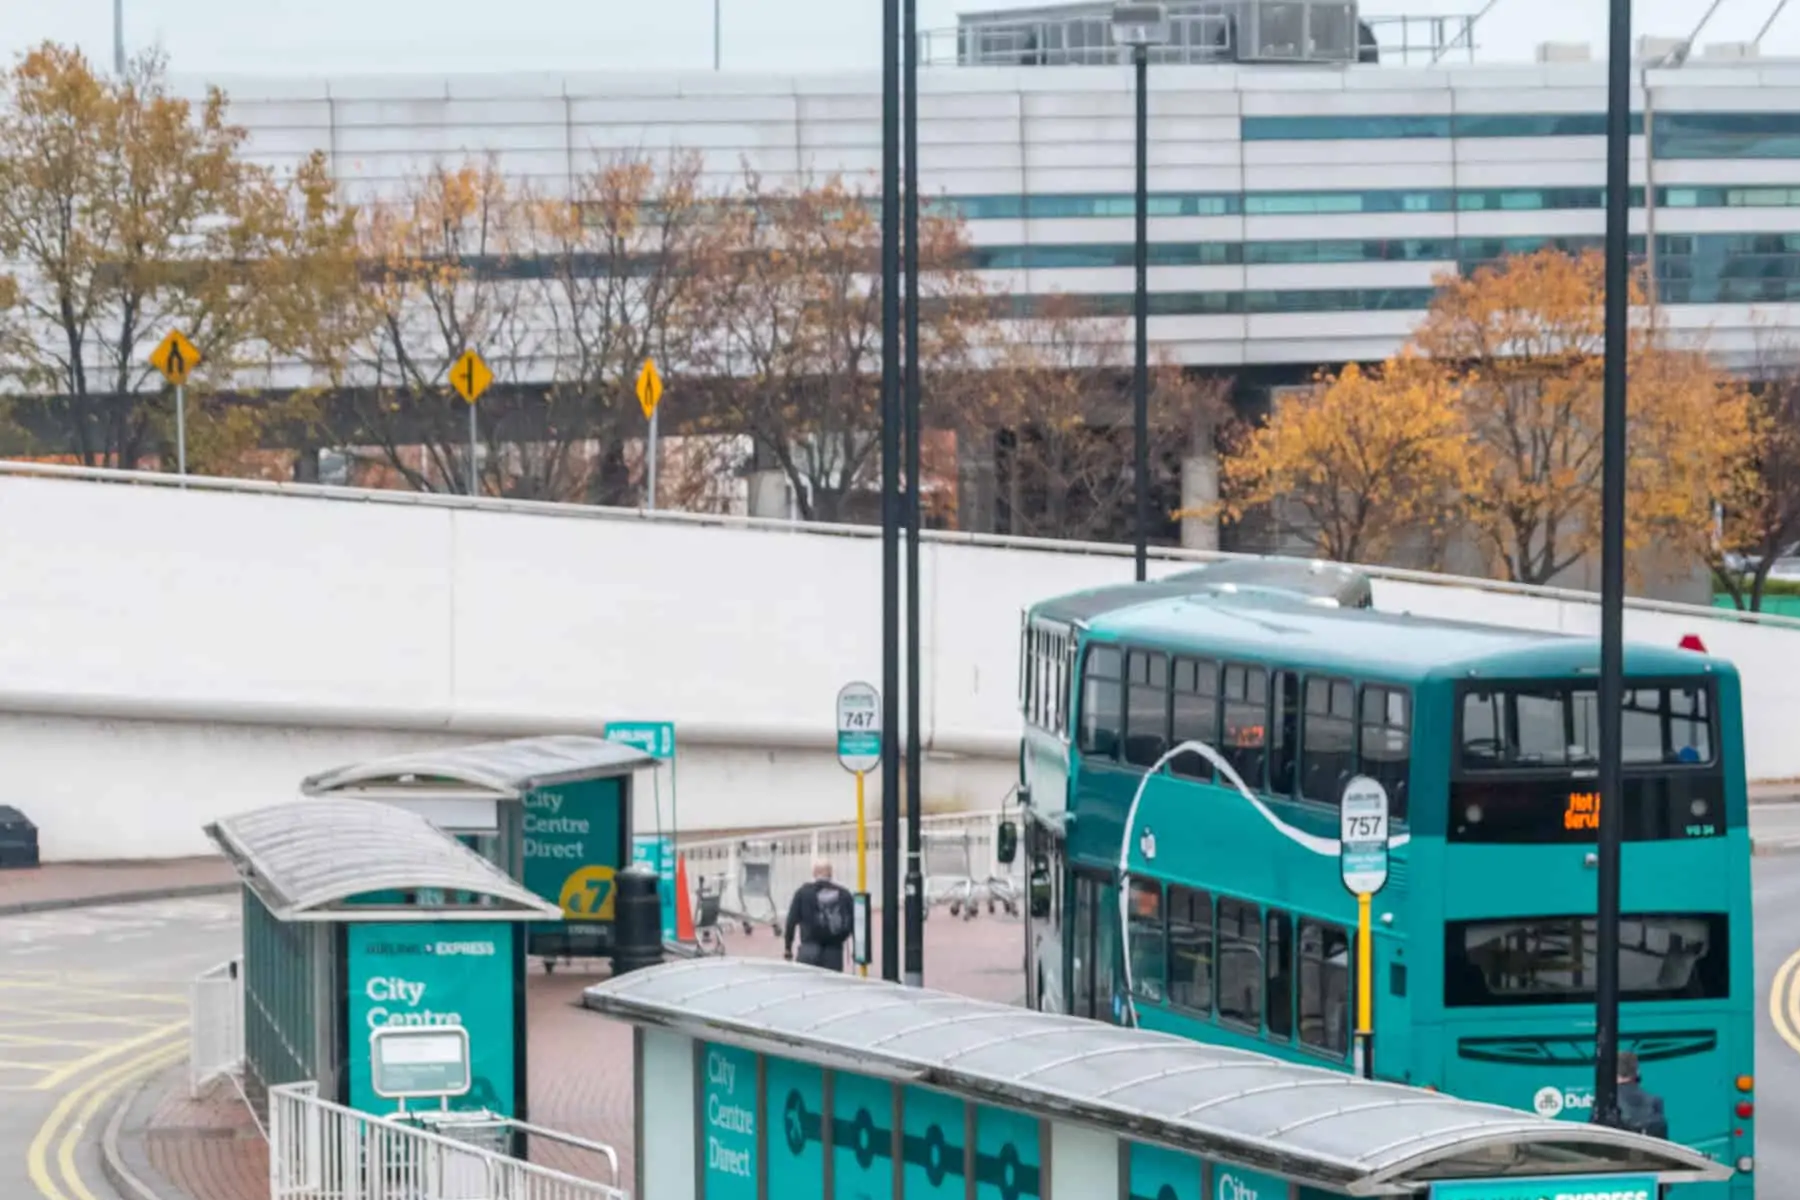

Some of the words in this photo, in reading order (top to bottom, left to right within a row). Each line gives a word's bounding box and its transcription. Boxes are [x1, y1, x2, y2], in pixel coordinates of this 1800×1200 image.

[844, 711, 875, 728] 747
[522, 791, 563, 812] City
[522, 815, 590, 834] Centre
[1348, 816, 1381, 837] 757
[523, 839, 584, 858] Direct
[435, 940, 495, 956] EXPRESS
[366, 977, 426, 1006] City
[367, 1007, 462, 1028] Centre
[708, 1051, 736, 1093] City
[1564, 1094, 1595, 1109] Dub
[708, 1093, 754, 1134] Centre
[709, 1134, 751, 1177] Direct
